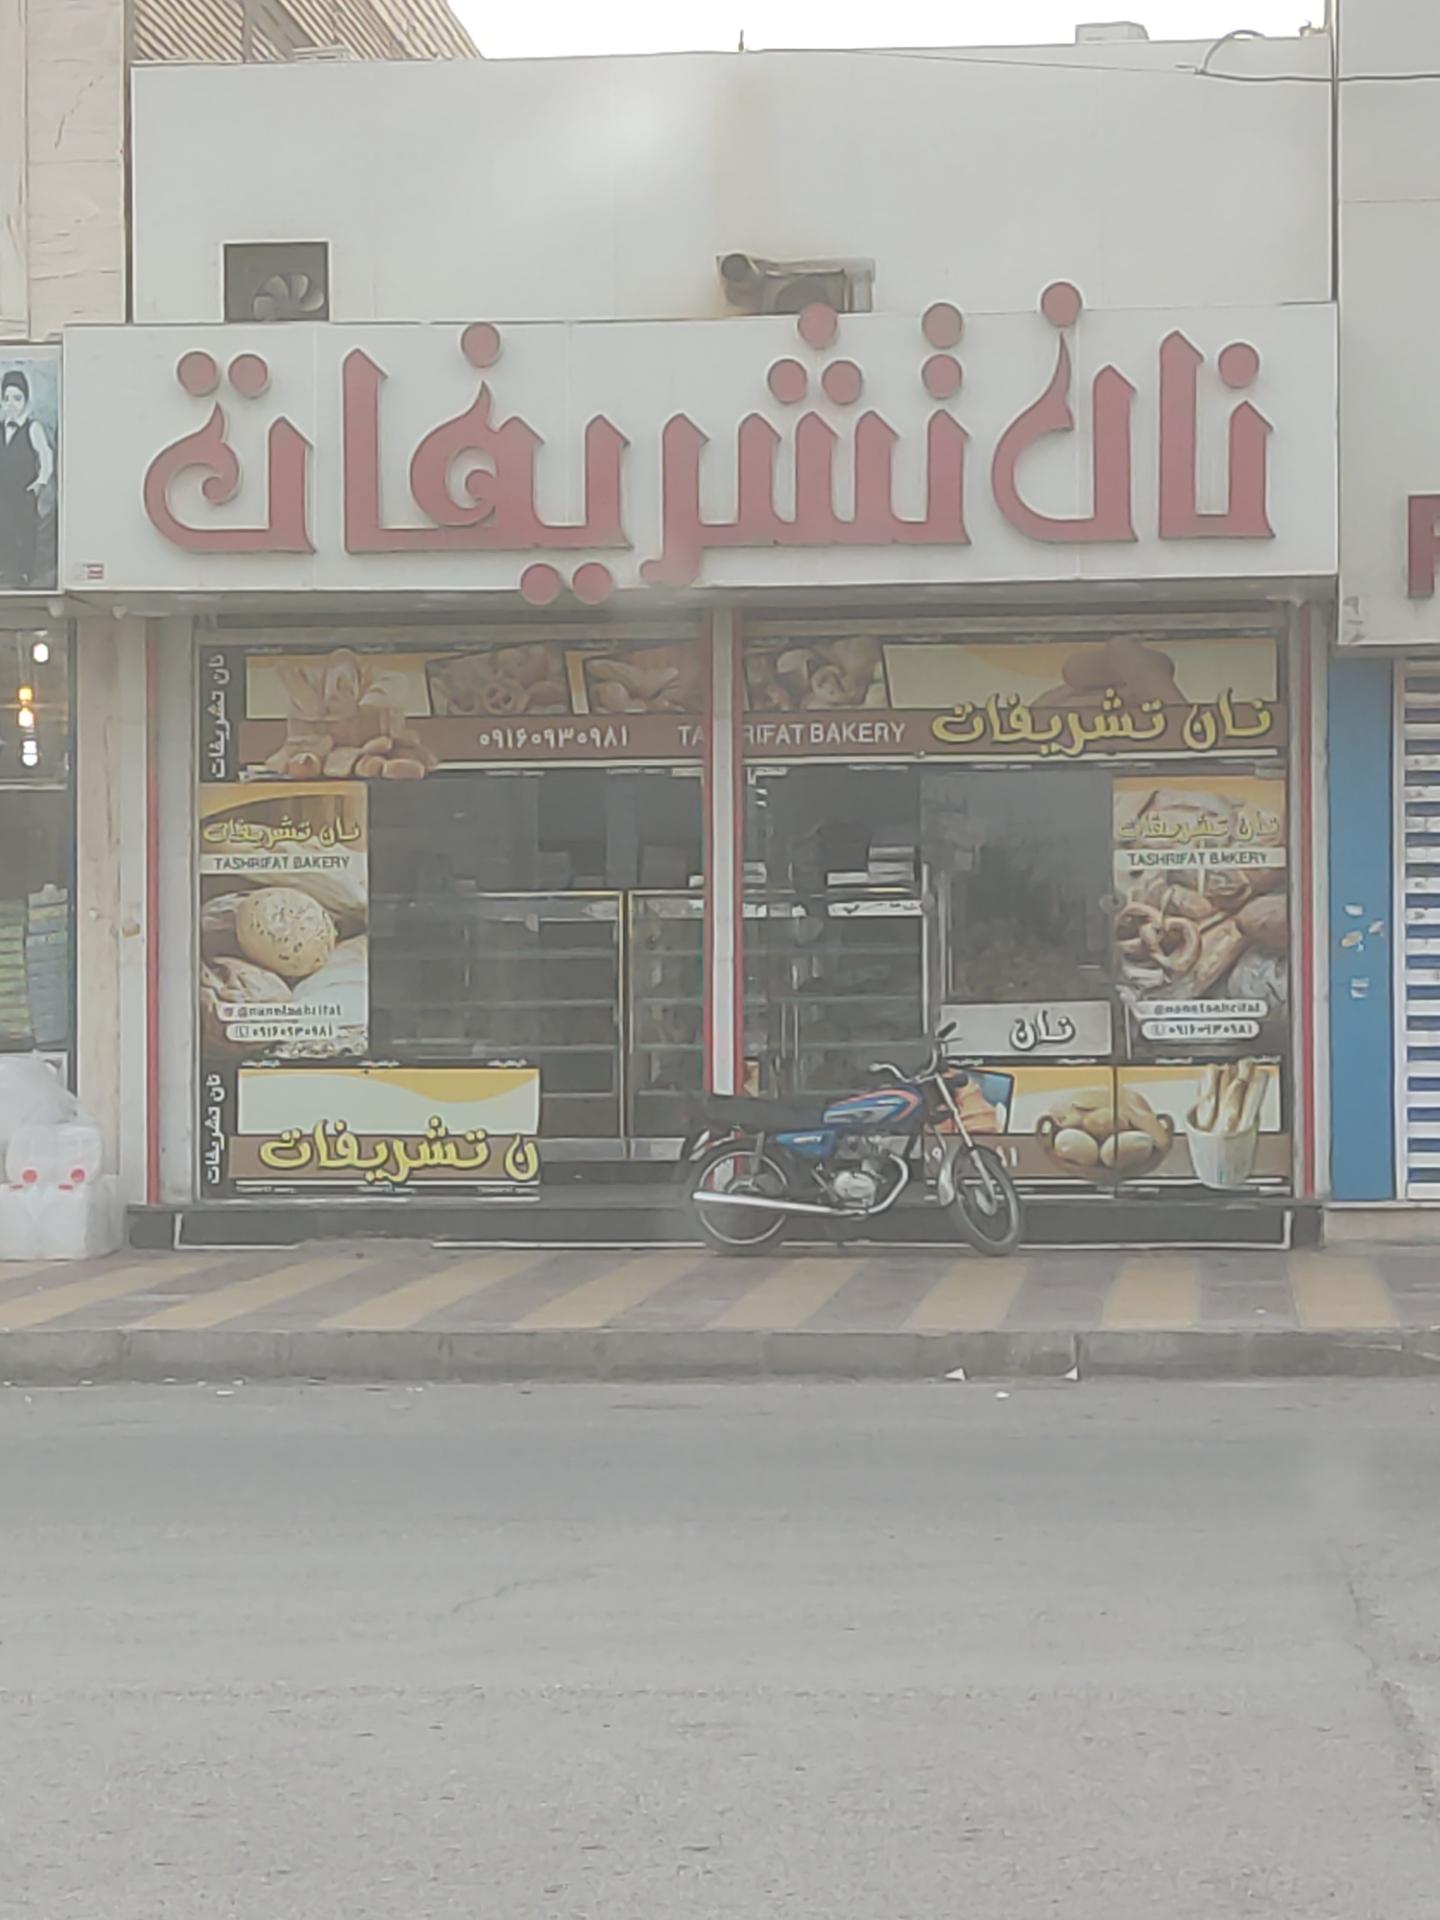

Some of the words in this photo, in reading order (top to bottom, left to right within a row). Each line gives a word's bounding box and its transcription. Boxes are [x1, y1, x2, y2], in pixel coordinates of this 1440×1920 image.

[992, 281, 1276, 543] نان
[143, 301, 971, 605] تشریفات
[208, 654, 231, 685] نان
[677, 724, 805, 747] TARIFAT
[810, 722, 905, 743] BAKERY
[931, 689, 1167, 757] تشریفات
[1181, 687, 1274, 751] نان
[479, 725, 629, 749] ۰۹۱۶۰۹۳۰۹۸۱
[203, 815, 312, 849] تشریفات
[318, 816, 361, 848] نان
[1118, 811, 1230, 844] تشریفات
[1237, 810, 1280, 843] نان
[215, 856, 289, 870] TASHRIFAT
[293, 856, 350, 870] BAKERY
[1128, 852, 1205, 866] TASHRIFAT
[1209, 852, 1268, 865] BAKERY
[1009, 1009, 1076, 1051] نان
[205, 1073, 226, 1103] نان
[259, 1115, 490, 1184] تشریفات
